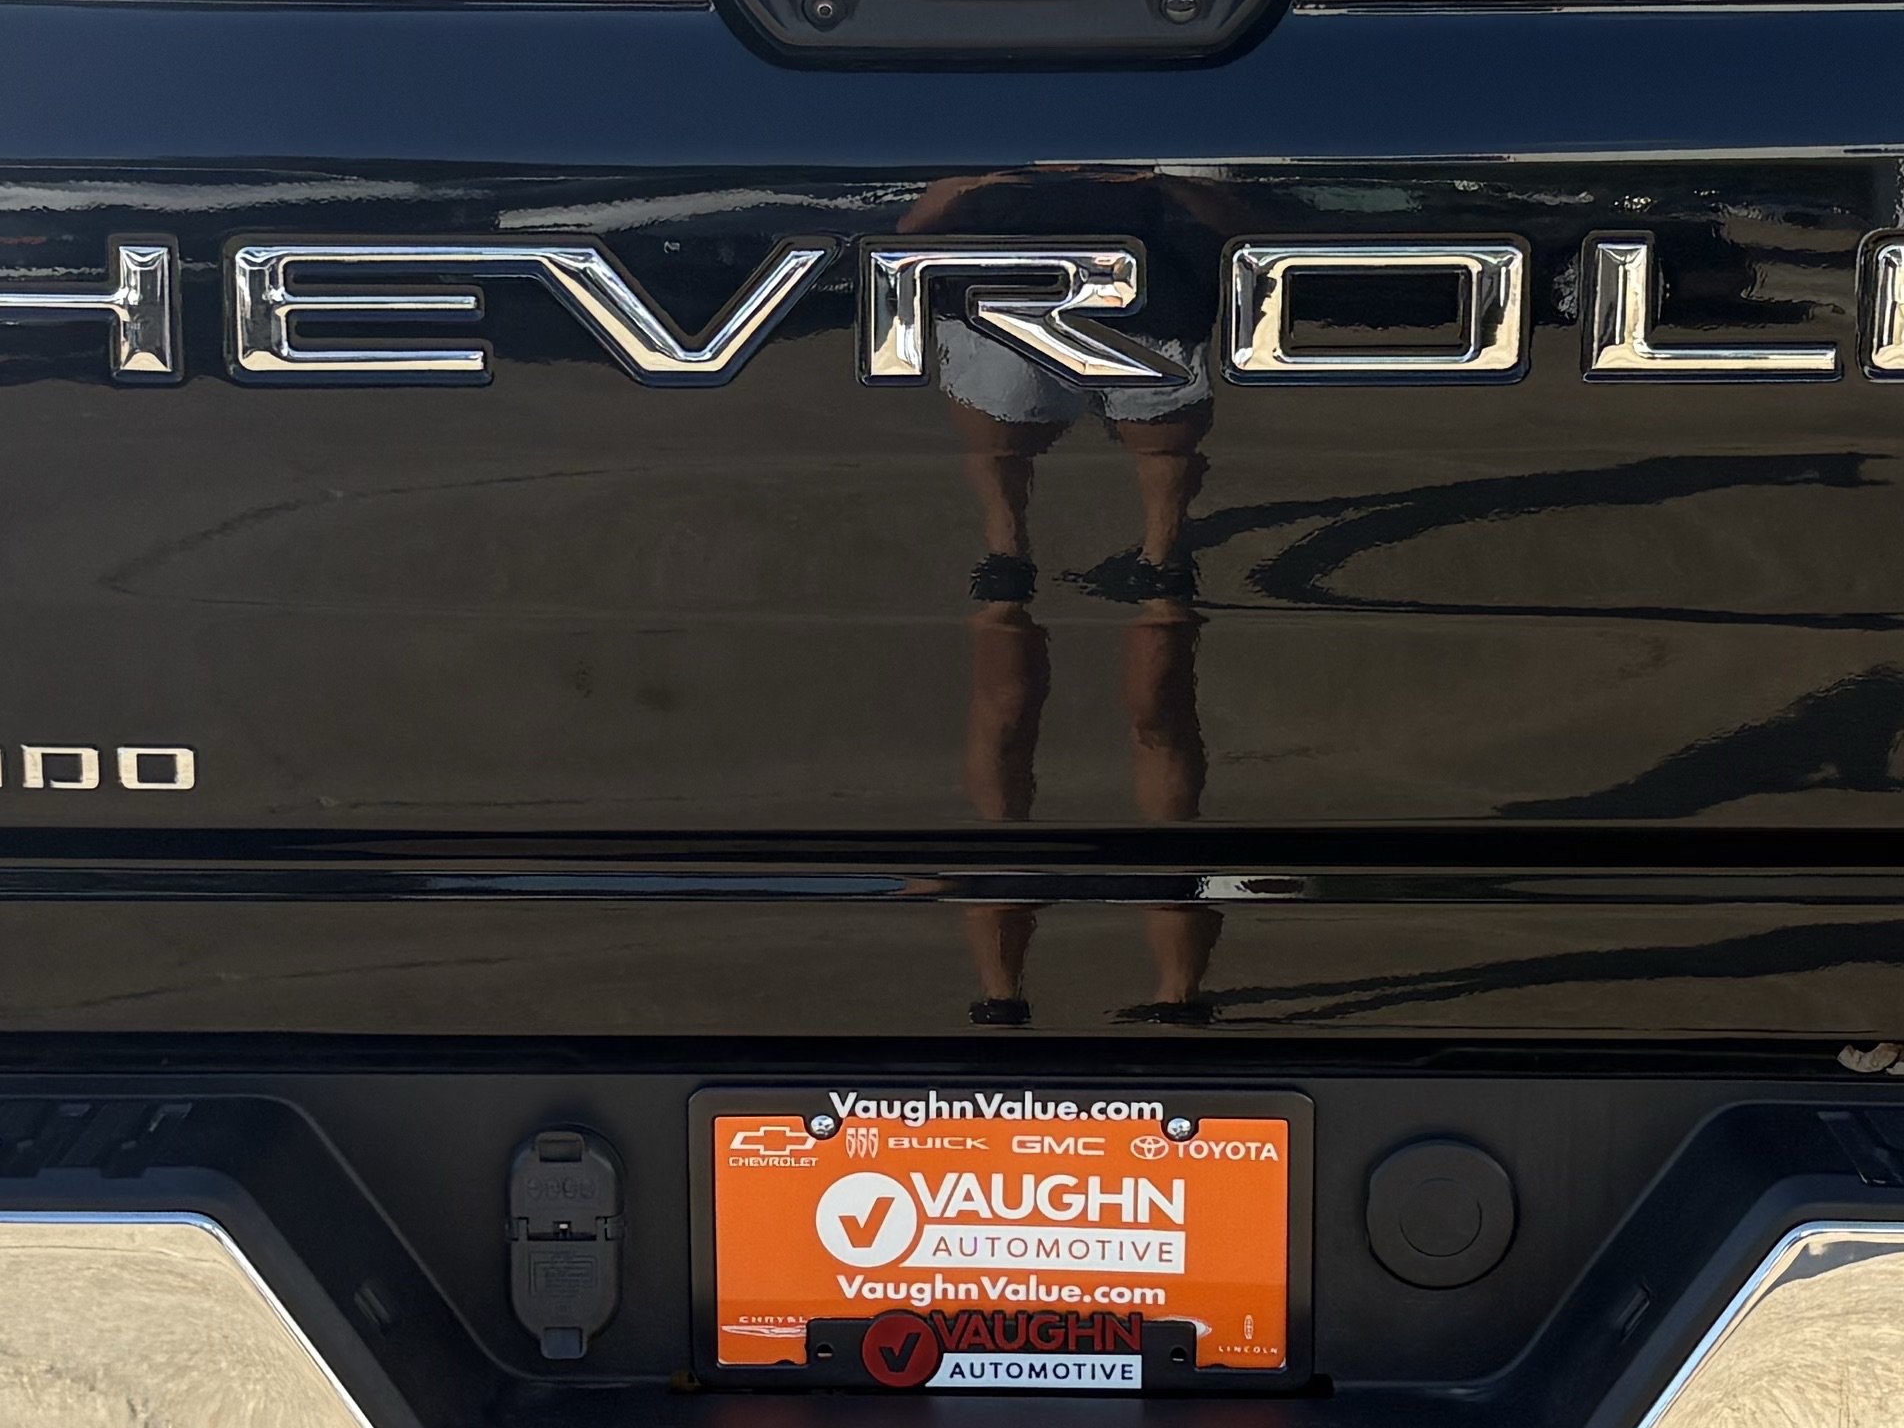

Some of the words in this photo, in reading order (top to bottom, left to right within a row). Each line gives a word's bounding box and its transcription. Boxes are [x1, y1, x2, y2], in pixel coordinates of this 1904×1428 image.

[828, 1090, 1165, 1128] VaughnValue.com
[887, 1135, 990, 1151] BUICK
[1011, 1135, 1106, 1156] GMC
[1174, 1139, 1279, 1162] TOYOTA
[728, 1155, 819, 1168] CHEVROLET
[909, 1172, 1186, 1226] VAUGHN
[931, 1235, 1175, 1264] AUTOMOTIVE
[835, 1273, 1167, 1306] VaughnValue.com
[738, 1315, 808, 1324] CHRYSL
[932, 1311, 1143, 1352] VAUGHN
[1217, 1345, 1278, 1354] LINCOLN
[948, 1360, 1135, 1381] AUTOMOTIVE
